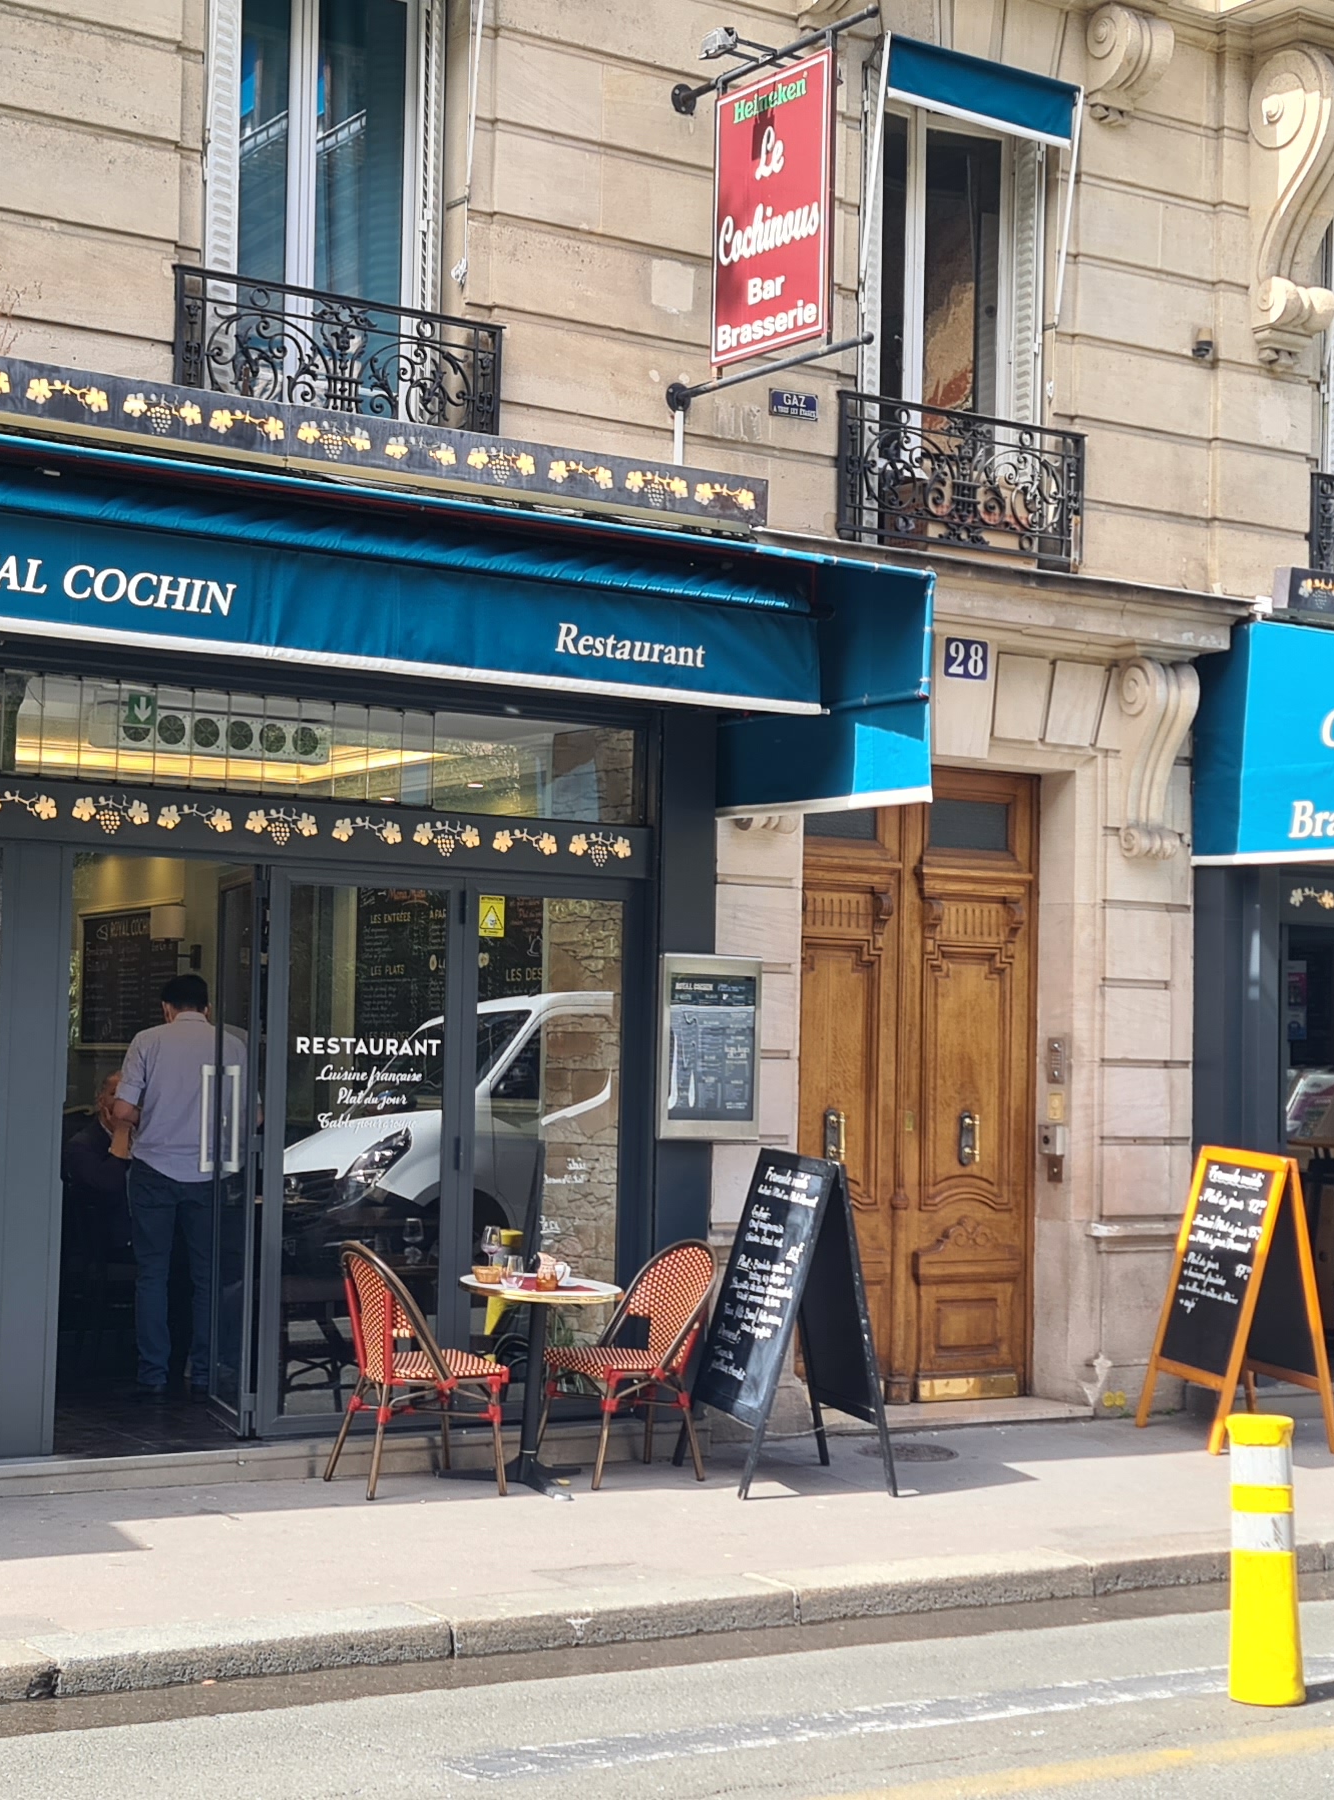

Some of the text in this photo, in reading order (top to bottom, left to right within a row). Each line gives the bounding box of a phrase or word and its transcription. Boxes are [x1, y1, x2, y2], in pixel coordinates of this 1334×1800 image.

[733, 78, 807, 124] Heineken
[755, 126, 784, 180] Le
[719, 202, 820, 266] Cochinous
[747, 275, 785, 305] Bar
[717, 299, 817, 352] Brasserie
[783, 393, 806, 407] GAZ
[63, 564, 237, 616] COCHIN
[555, 622, 705, 668] Restaurant
[948, 641, 983, 676] 28
[506, 968, 522, 981] LES
[296, 1036, 441, 1056] RESTAURANT
[316, 1064, 423, 1088] Cuisine française
[337, 1087, 407, 1110] Plat du jour
[318, 1112, 352, 1129] Table
